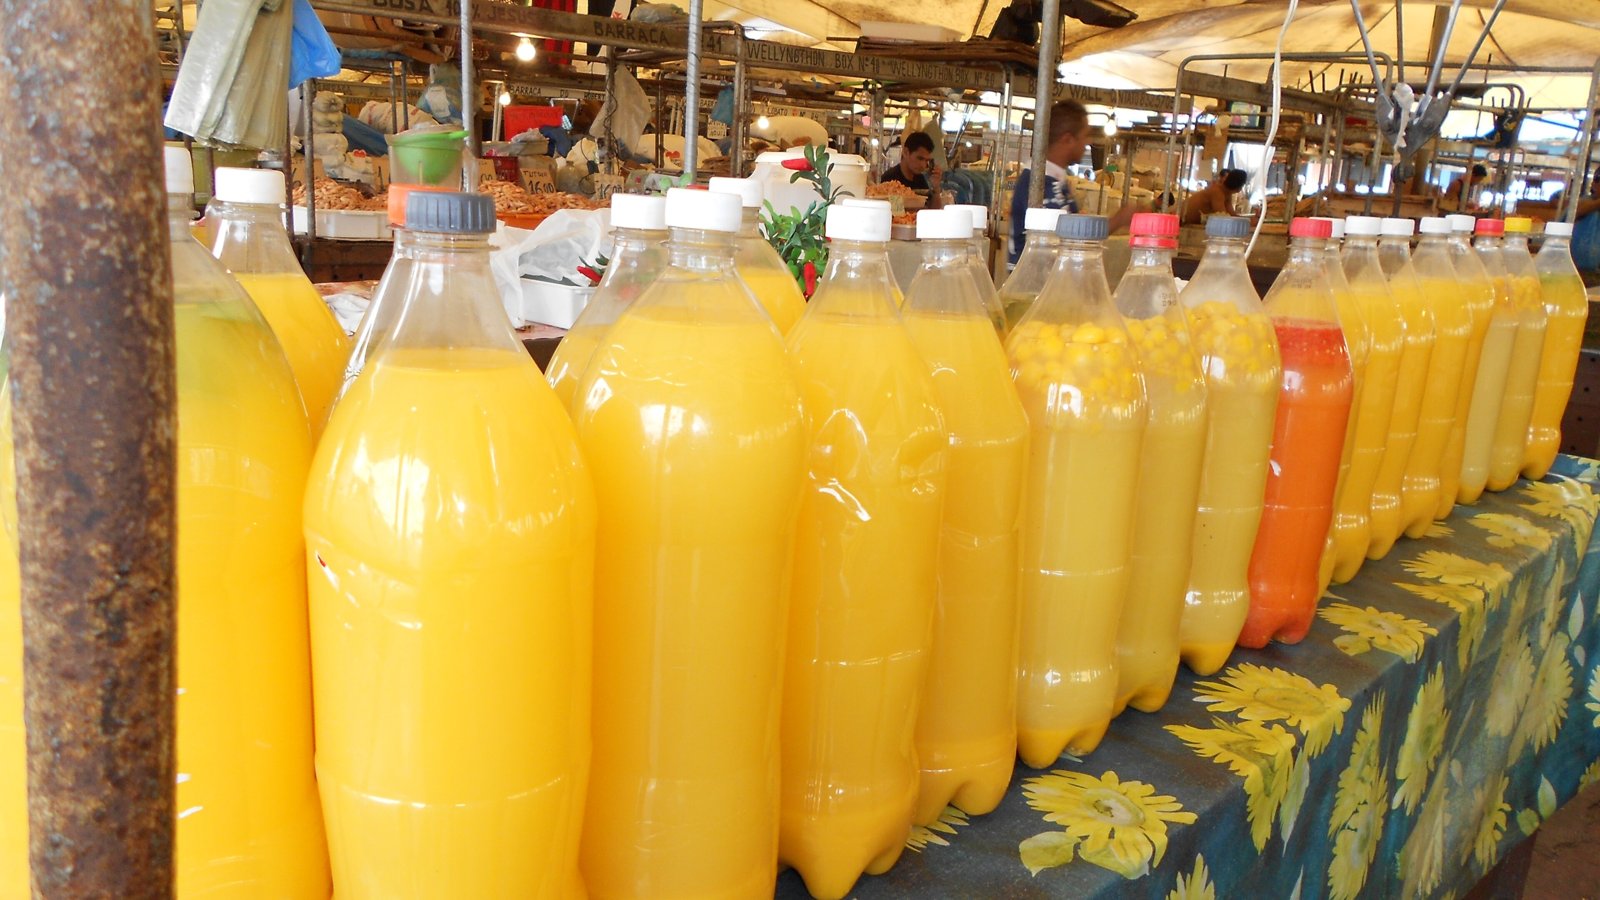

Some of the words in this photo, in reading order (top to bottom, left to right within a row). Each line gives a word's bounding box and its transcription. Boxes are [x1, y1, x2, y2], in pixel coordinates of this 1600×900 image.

[593, 21, 669, 46] BARRACA
[746, 42, 825, 67] WELLYNGTHON
[835, 53, 854, 70] BOX
[509, 84, 541, 95] BARRACA
[1069, 84, 1102, 102] WALL
